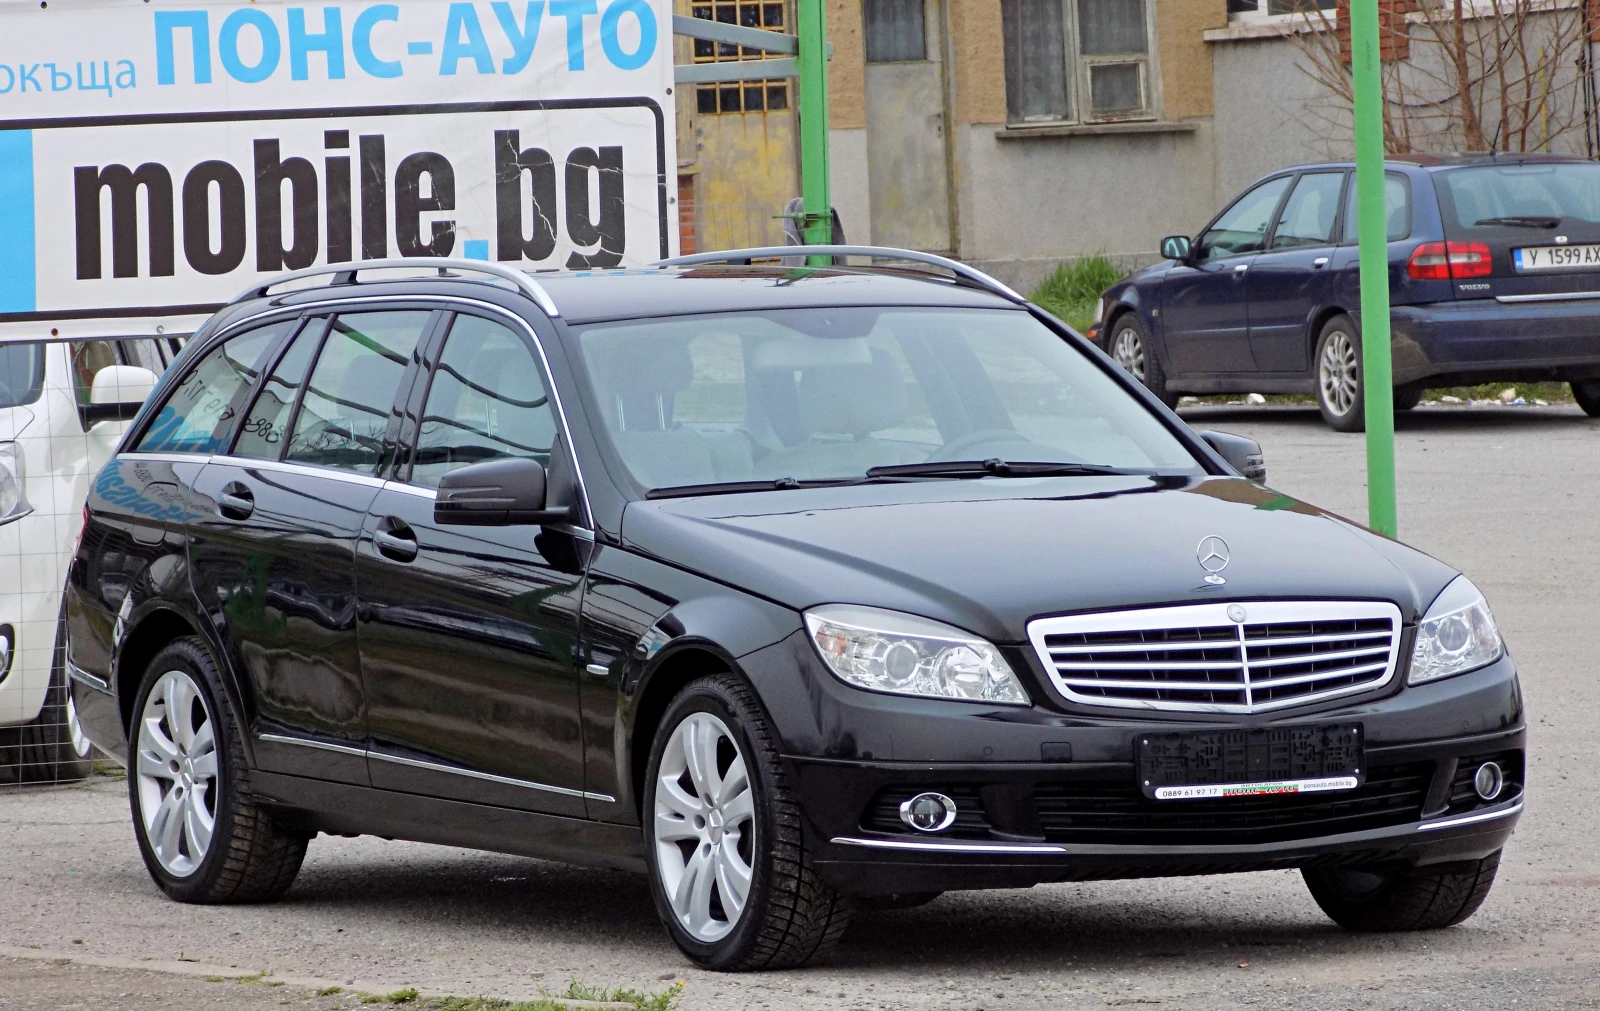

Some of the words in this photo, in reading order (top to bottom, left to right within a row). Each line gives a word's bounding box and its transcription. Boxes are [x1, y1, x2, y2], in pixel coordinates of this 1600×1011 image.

[154, 0, 658, 86] ПОНС-АУТО
[73, 129, 625, 280] mobile.bg
[1548, 247, 1581, 265] 1599
[1459, 283, 1490, 291] VOLVO
[1162, 789, 1182, 798] 0889
[1184, 788, 1194, 797] 61
[1196, 788, 1206, 796] 97
[1208, 787, 1218, 796] 17
